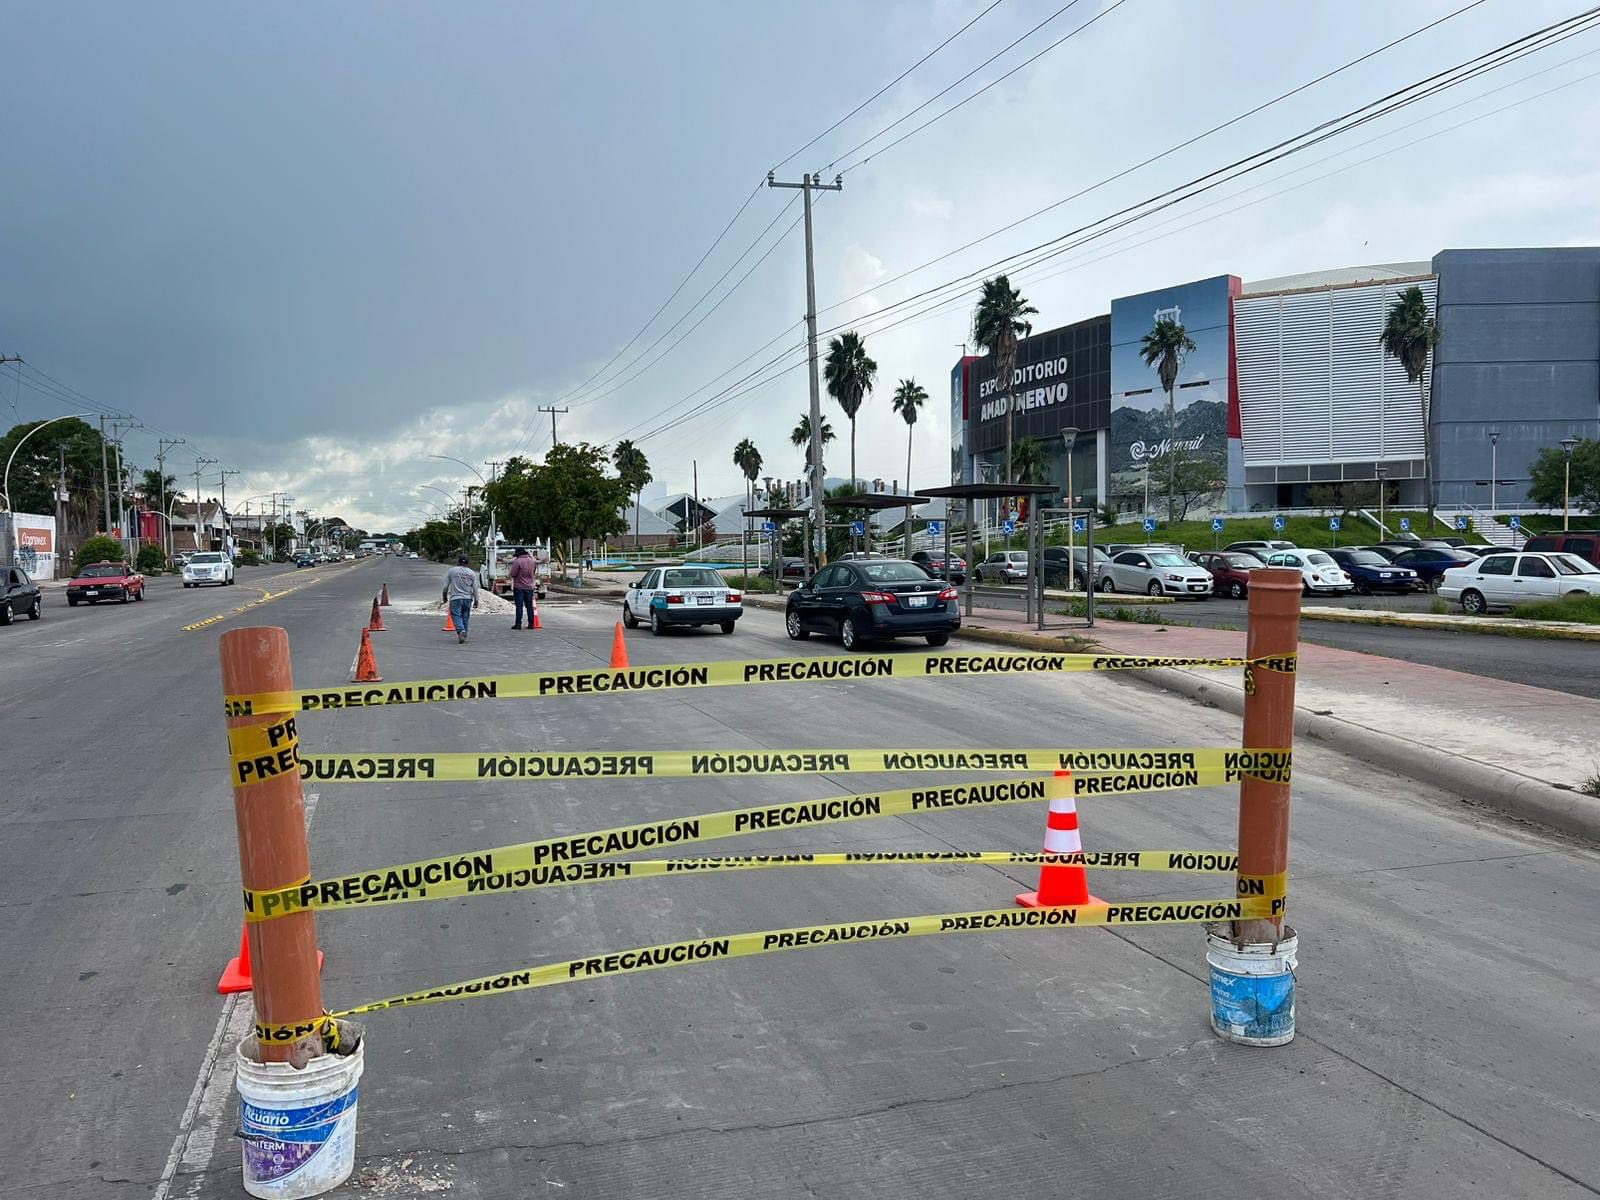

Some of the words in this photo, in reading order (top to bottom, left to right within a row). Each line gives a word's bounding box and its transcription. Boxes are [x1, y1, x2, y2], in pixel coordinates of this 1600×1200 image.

[1003, 357, 1068, 389] DITORIO
[1016, 382, 1068, 411] NERVO
[1150, 434, 1205, 459] Nyarit
[301, 681, 496, 710] PRECAUCIÓN
[539, 667, 708, 694] PRECAUCIÓN
[744, 659, 893, 682] PRECAUCIÓN
[926, 657, 1065, 673] PRECAUCIÓN
[300, 855, 492, 907] PRECAUCIÓN
[534, 821, 700, 865] PRECAUCIÓN
[735, 797, 881, 832] PRECAUCIÓN
[911, 782, 1045, 809] PRECAUCIÓN
[1074, 770, 1198, 795] PRECAUCIÓN
[569, 940, 730, 977] PRECAUCIÓN
[763, 922, 910, 949] PRECAUCIÓN
[940, 909, 1076, 931] PRECAUCIÓN
[1106, 903, 1241, 922] PRECAUCIÓN
[245, 1104, 289, 1125] Acuario
